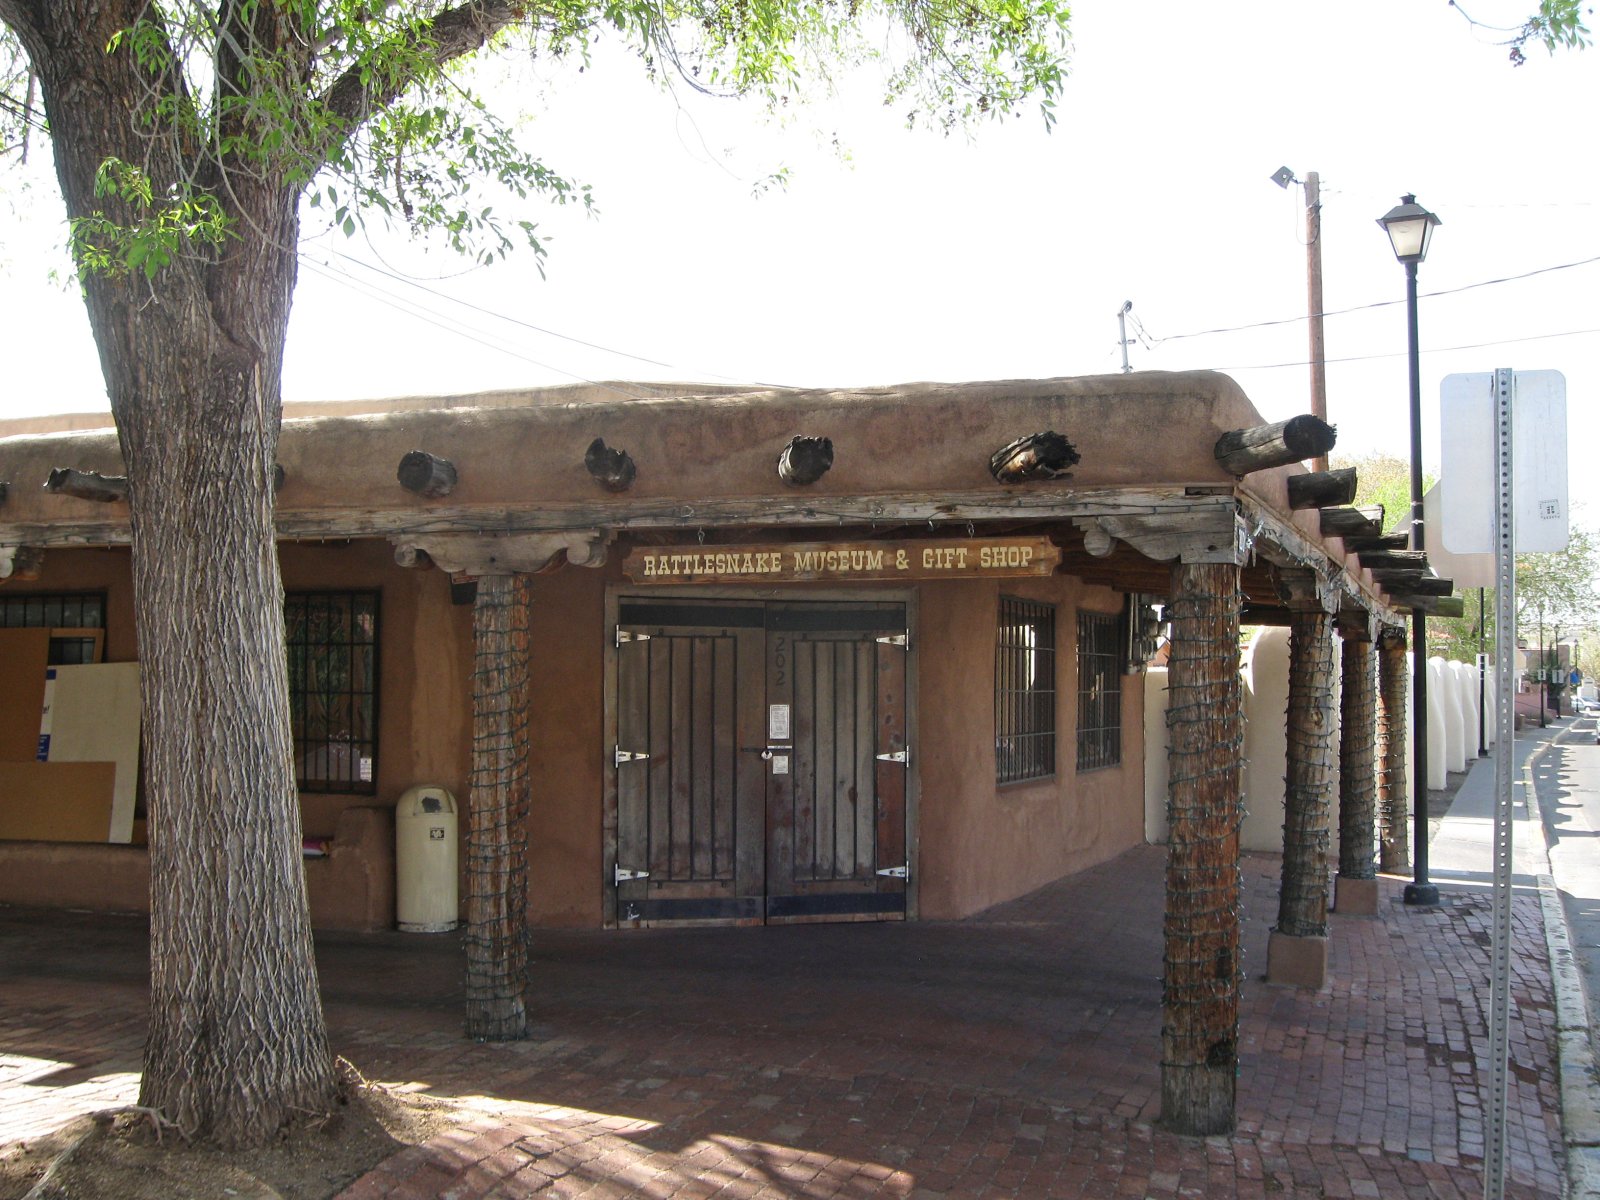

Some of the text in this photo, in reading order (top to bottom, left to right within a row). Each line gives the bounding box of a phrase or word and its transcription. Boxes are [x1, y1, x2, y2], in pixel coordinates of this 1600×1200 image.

[643, 546, 1033, 576] RATTLESNAKE MUSEUM & GIFT SHOP
[775, 636, 786, 686] 202
